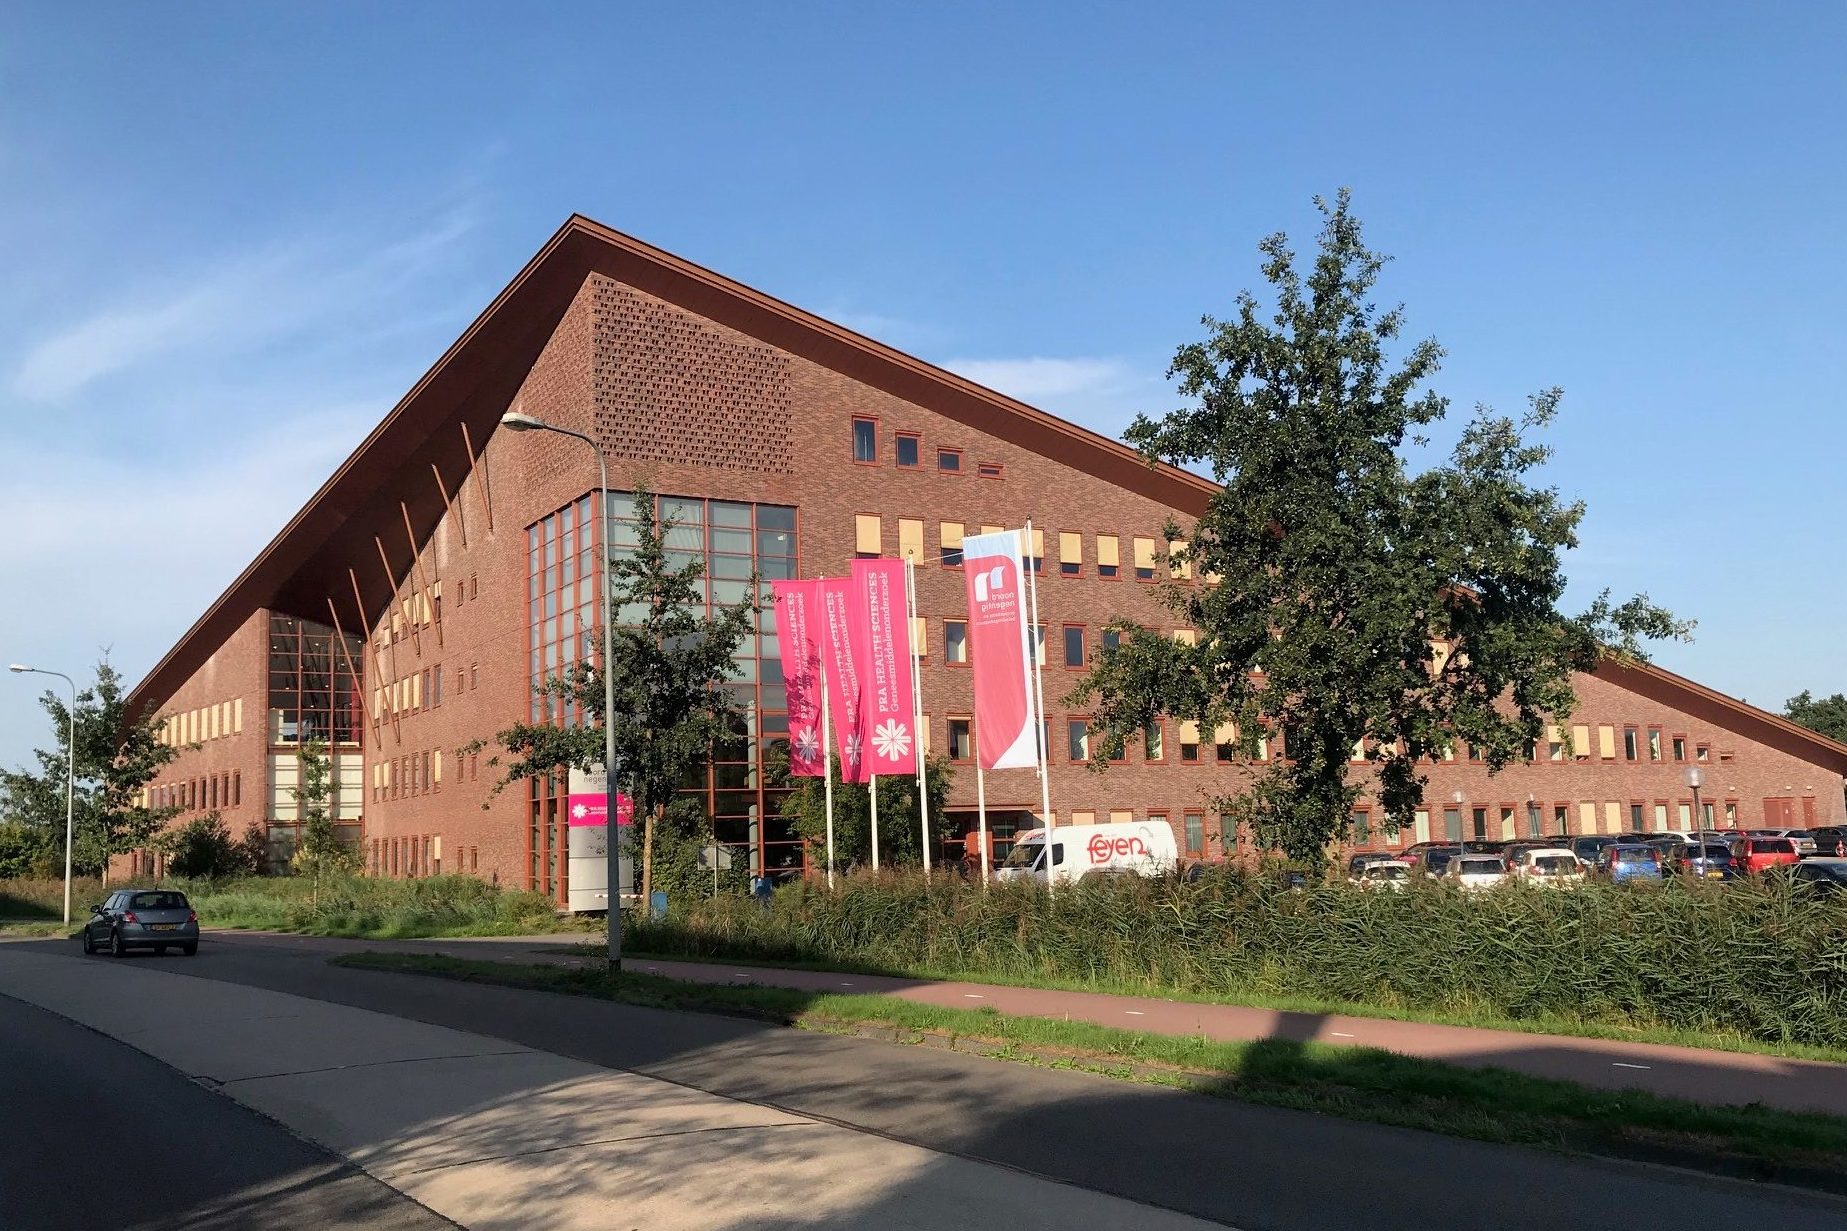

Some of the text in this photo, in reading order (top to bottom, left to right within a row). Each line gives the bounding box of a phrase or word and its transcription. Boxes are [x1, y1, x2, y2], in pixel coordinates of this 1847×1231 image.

[786, 592, 798, 646] SCIENCES
[825, 592, 840, 648] SCIENCES
[868, 572, 889, 712] PRA HEALTH SCIENCES
[880, 571, 899, 712] Geneesmiddelenonderzoek
[846, 700, 855, 723] PRA
